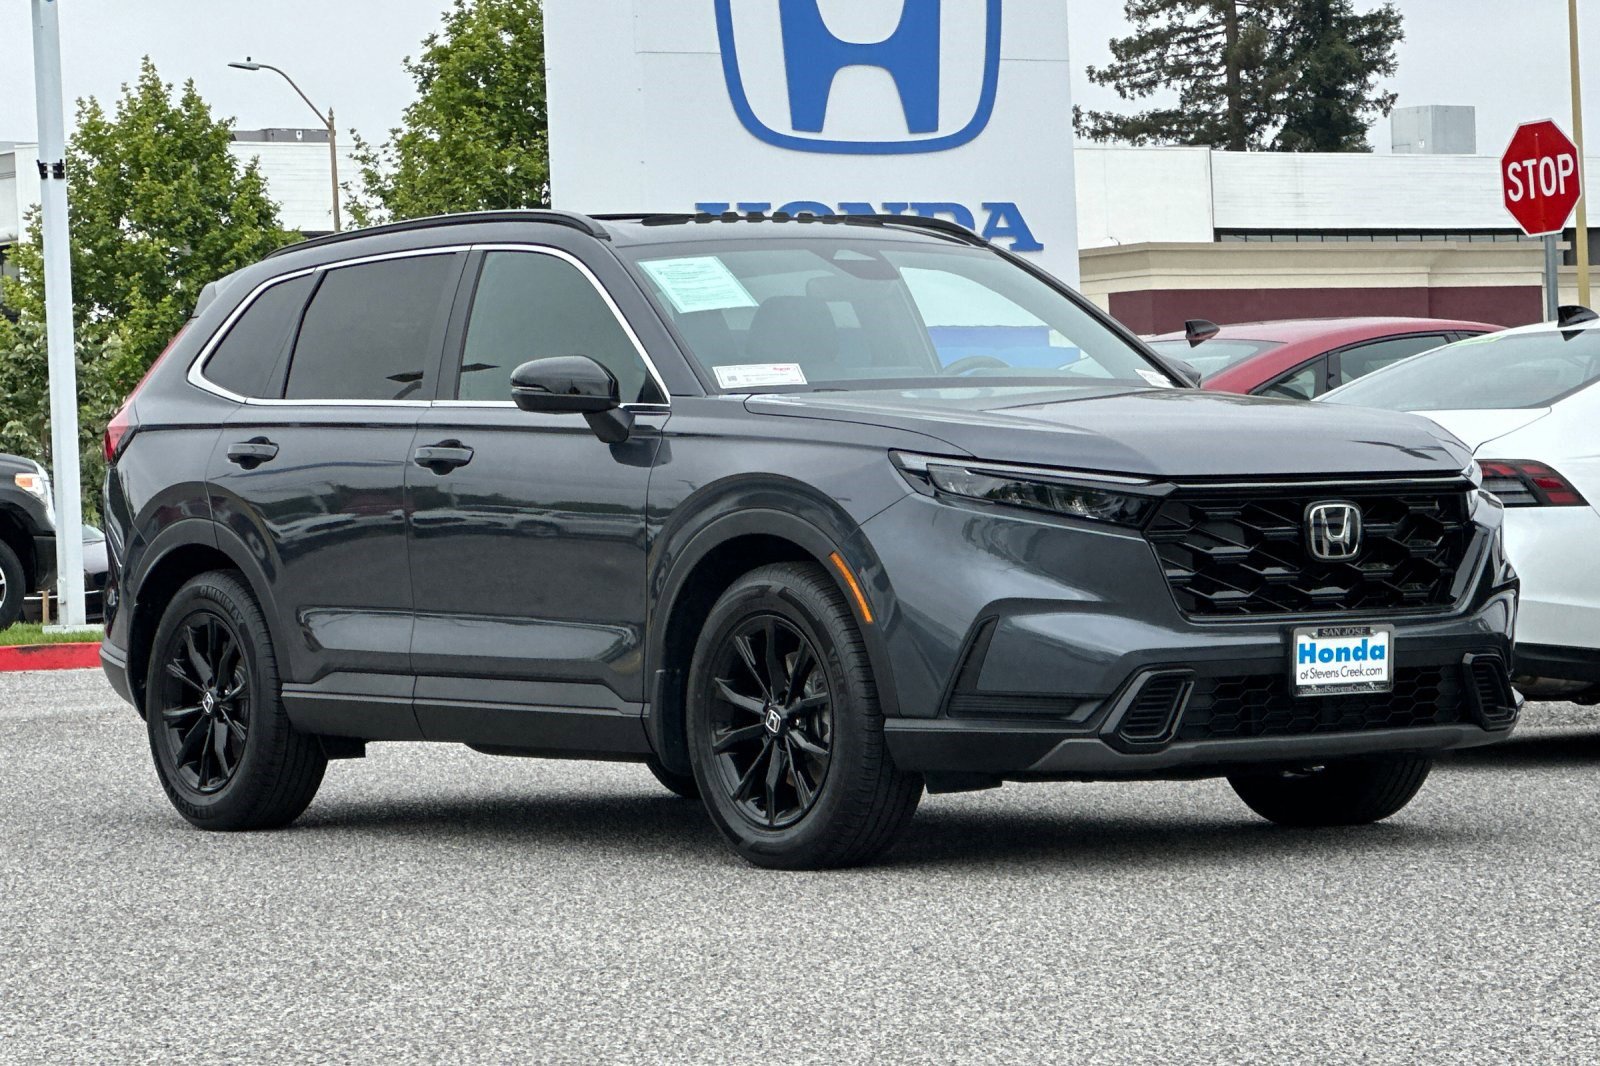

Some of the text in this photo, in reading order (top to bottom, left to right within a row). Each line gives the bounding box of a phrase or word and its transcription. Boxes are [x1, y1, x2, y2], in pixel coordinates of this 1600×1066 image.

[1507, 153, 1574, 202] STOP
[1321, 627, 1367, 637] SAN JOSE
[1299, 639, 1385, 664] Honda
[1300, 664, 1383, 680] of Stevens Creek.com
